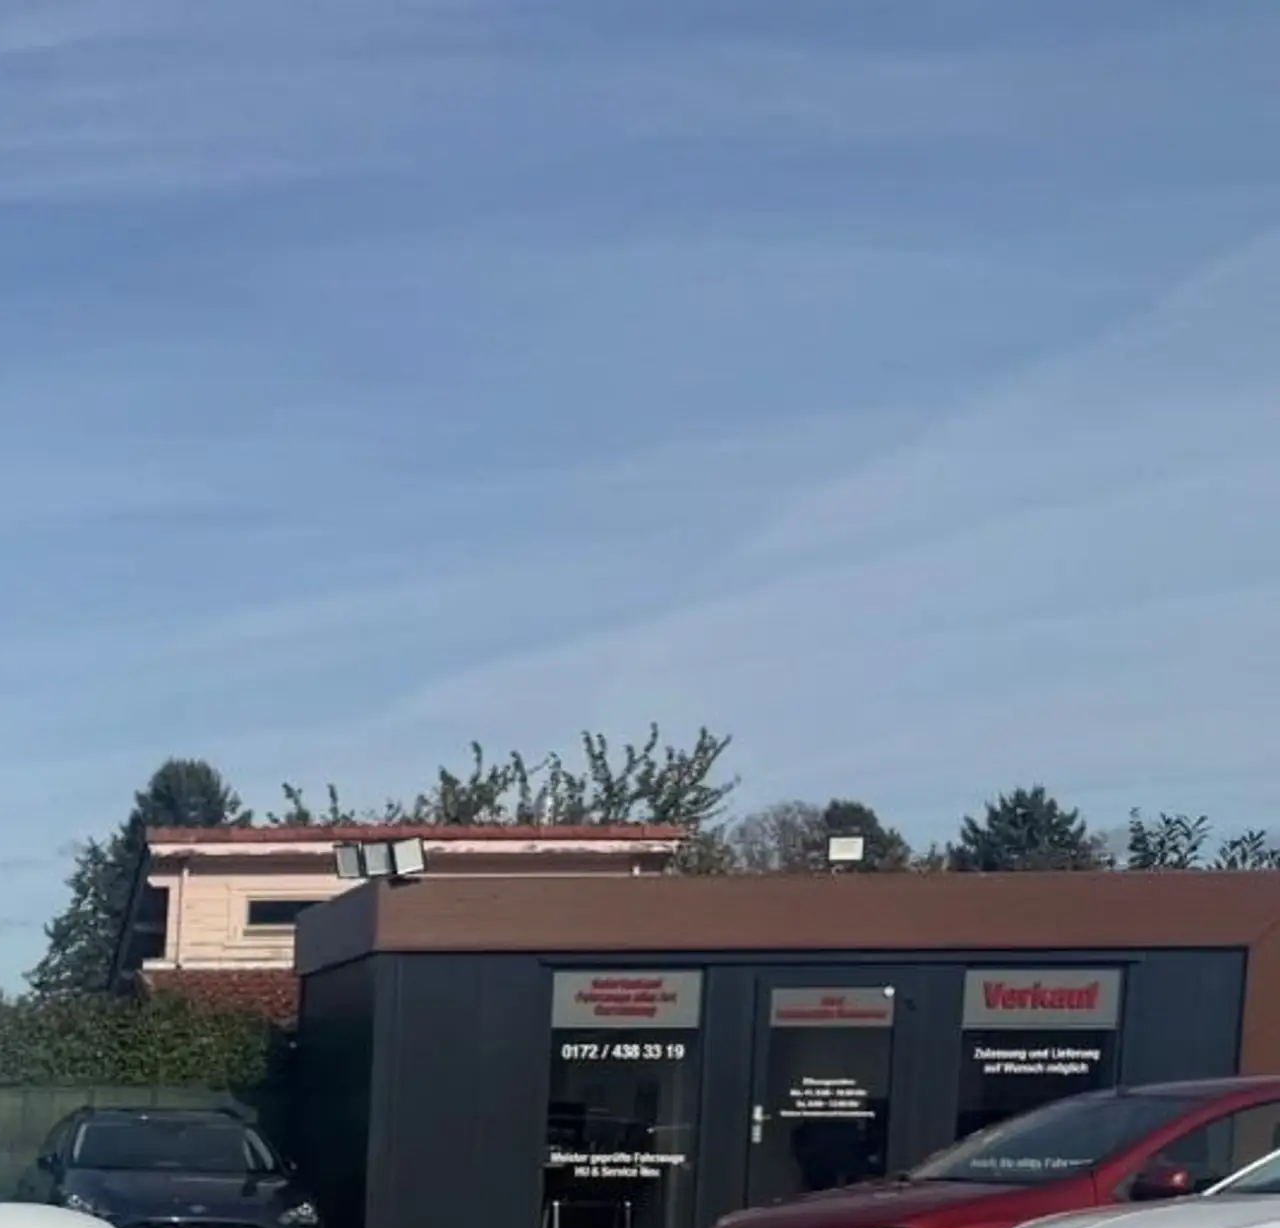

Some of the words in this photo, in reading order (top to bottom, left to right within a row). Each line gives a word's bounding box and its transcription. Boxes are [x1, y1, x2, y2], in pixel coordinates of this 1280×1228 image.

[983, 980, 1100, 1010] Verkauf
[562, 1043, 599, 1060] 0172
[611, 1043, 640, 1060] 438
[642, 1043, 662, 1060] 33
[666, 1043, 685, 1060] 19
[973, 1047, 1027, 1060] Zulassung
[1028, 1047, 1048, 1060] und
[1052, 1047, 1101, 1061] Lieferung
[983, 1063, 1002, 1074] auf
[1003, 1063, 1044, 1074] Wunsch
[1046, 1062, 1090, 1076] möglich
[601, 1166, 638, 1177] Service
